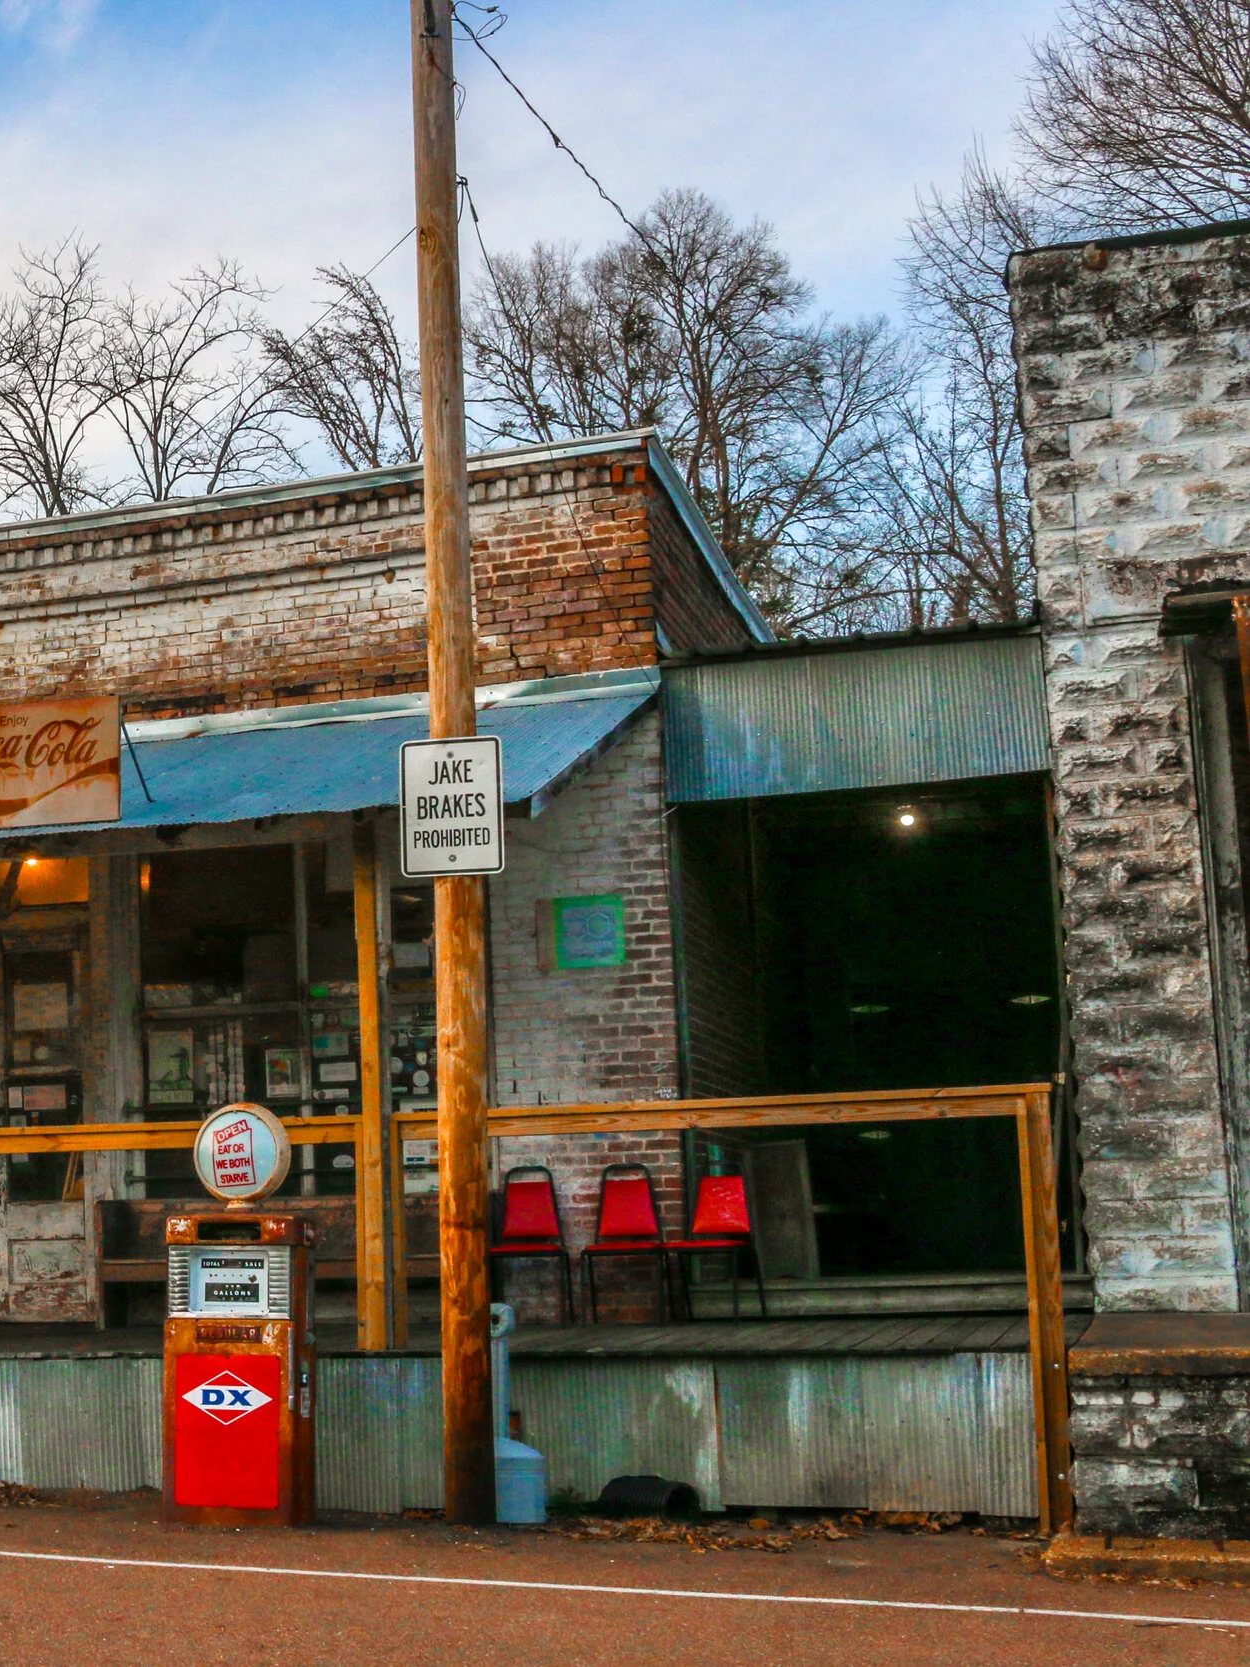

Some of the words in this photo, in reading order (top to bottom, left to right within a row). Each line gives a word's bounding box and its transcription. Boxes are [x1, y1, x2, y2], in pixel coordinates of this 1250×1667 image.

[0, 715, 29, 728] Enjoy
[428, 759, 474, 785] JAKE
[417, 792, 486, 820] BRAKES
[413, 827, 490, 849] PROHIBITED
[217, 1121, 248, 1141] OPEN
[218, 1145, 231, 1155] EAT
[233, 1143, 244, 1153] OR
[216, 1160, 228, 1169] WE
[229, 1158, 250, 1168] BOTH
[220, 1172, 249, 1184] STARVE
[200, 1389, 252, 1406] DX
